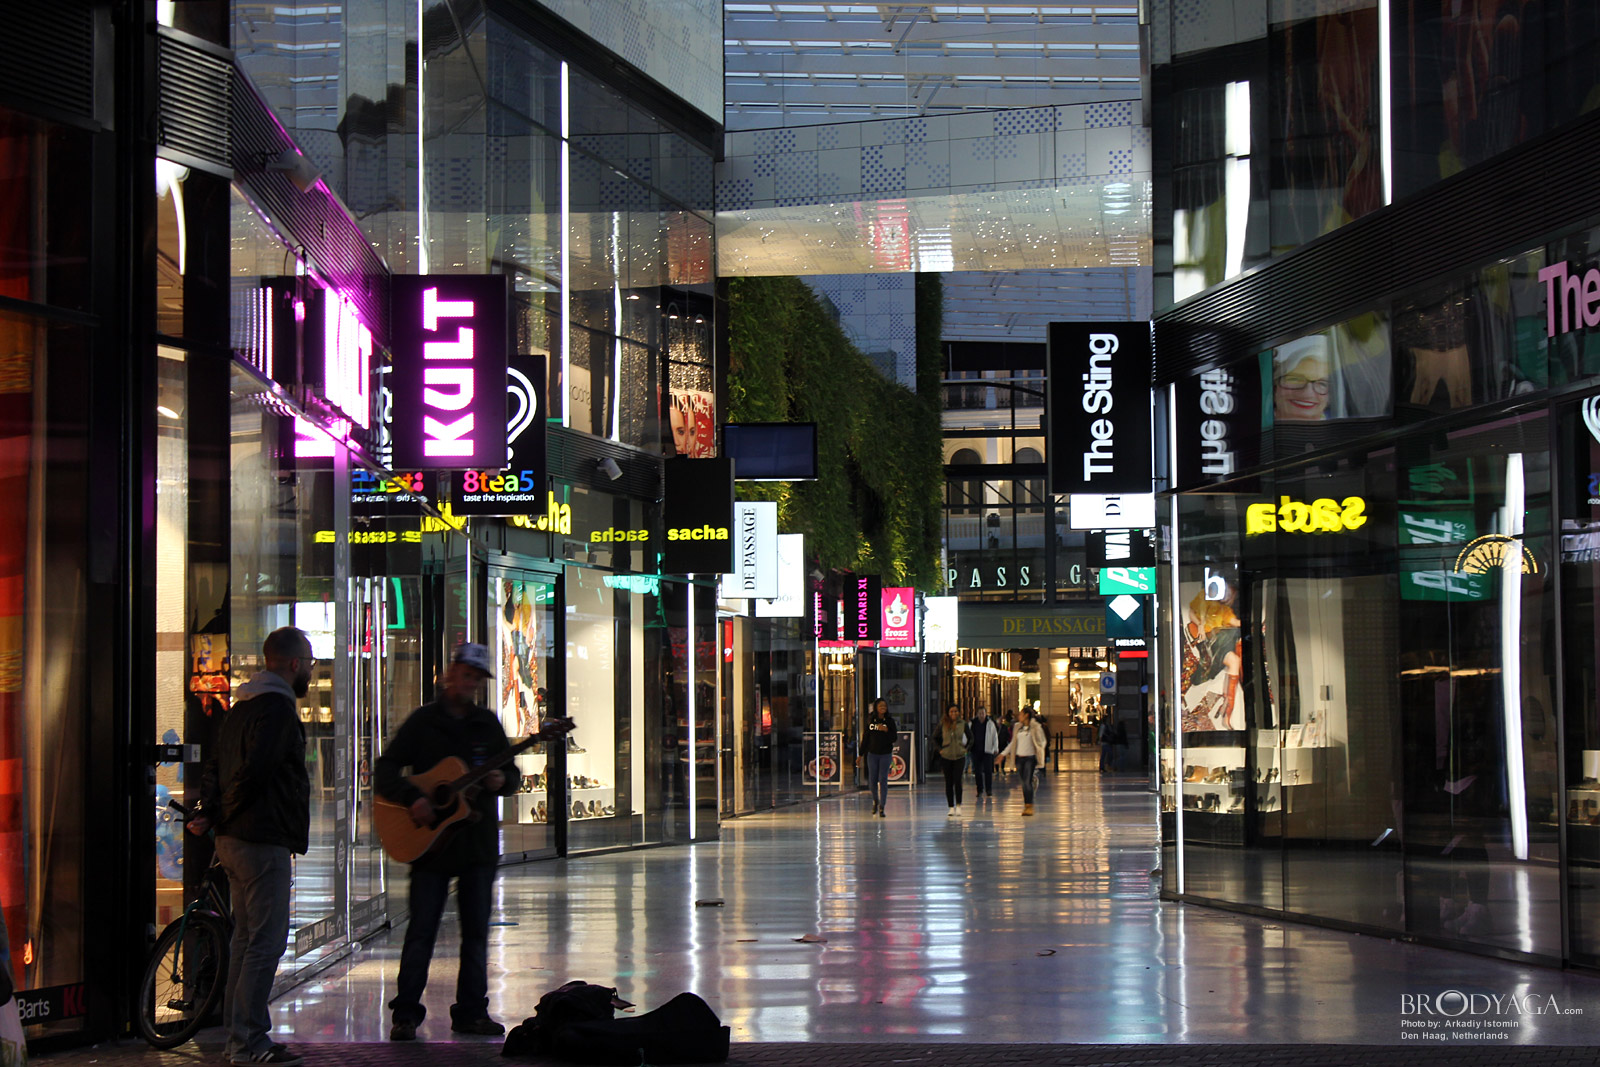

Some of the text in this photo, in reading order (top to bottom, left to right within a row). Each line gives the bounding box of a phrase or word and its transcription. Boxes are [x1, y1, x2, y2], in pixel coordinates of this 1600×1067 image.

[1539, 261, 1600, 338] The
[422, 286, 475, 457] KULT
[1082, 333, 1119, 482] The Sting
[463, 469, 535, 493] 8tea5
[463, 493, 535, 504] taste the inspiration
[667, 524, 729, 541] sacha
[743, 507, 756, 590] DE PASSAGE
[857, 577, 868, 638] ICI PARIS XL
[884, 627, 909, 638] frozz
[1002, 618, 1106, 633] DE PASSAGE
[17, 998, 50, 1021] Barts
